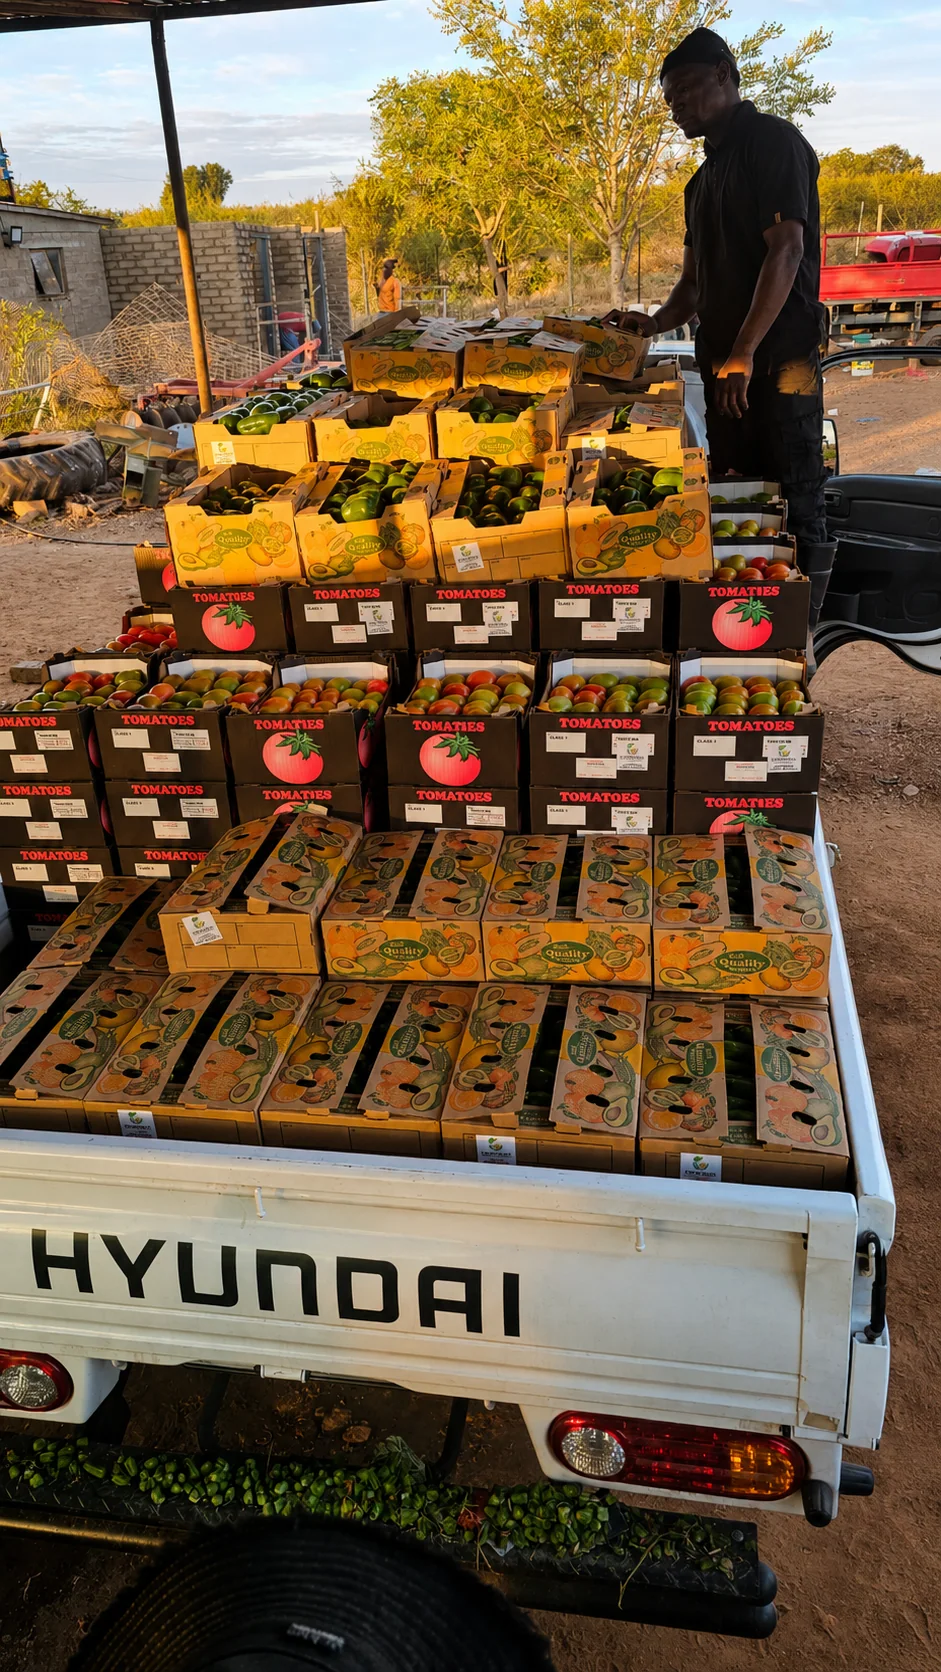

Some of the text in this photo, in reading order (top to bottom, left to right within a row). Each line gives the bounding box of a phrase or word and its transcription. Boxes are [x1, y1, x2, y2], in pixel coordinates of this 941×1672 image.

[621, 529, 658, 543] Quality
[313, 588, 380, 600] TOMATOES
[436, 589, 506, 600] TOMATOES
[566, 584, 639, 595] TOMATOES
[121, 715, 195, 726] TOMATOES
[559, 717, 641, 730] TOMATOES
[708, 720, 795, 732] TOMATOES
[3, 785, 72, 796] TOMATOES
[131, 784, 204, 795] TOMATOES
[416, 790, 492, 802] TOMATOES
[559, 791, 640, 804] TOMATOES
[20, 850, 89, 861] TOMATOES
[383, 947, 424, 957] Quality
[545, 949, 590, 961] Quality
[719, 957, 766, 969] Quality
[31, 1228, 520, 1337] HYUNDAI
